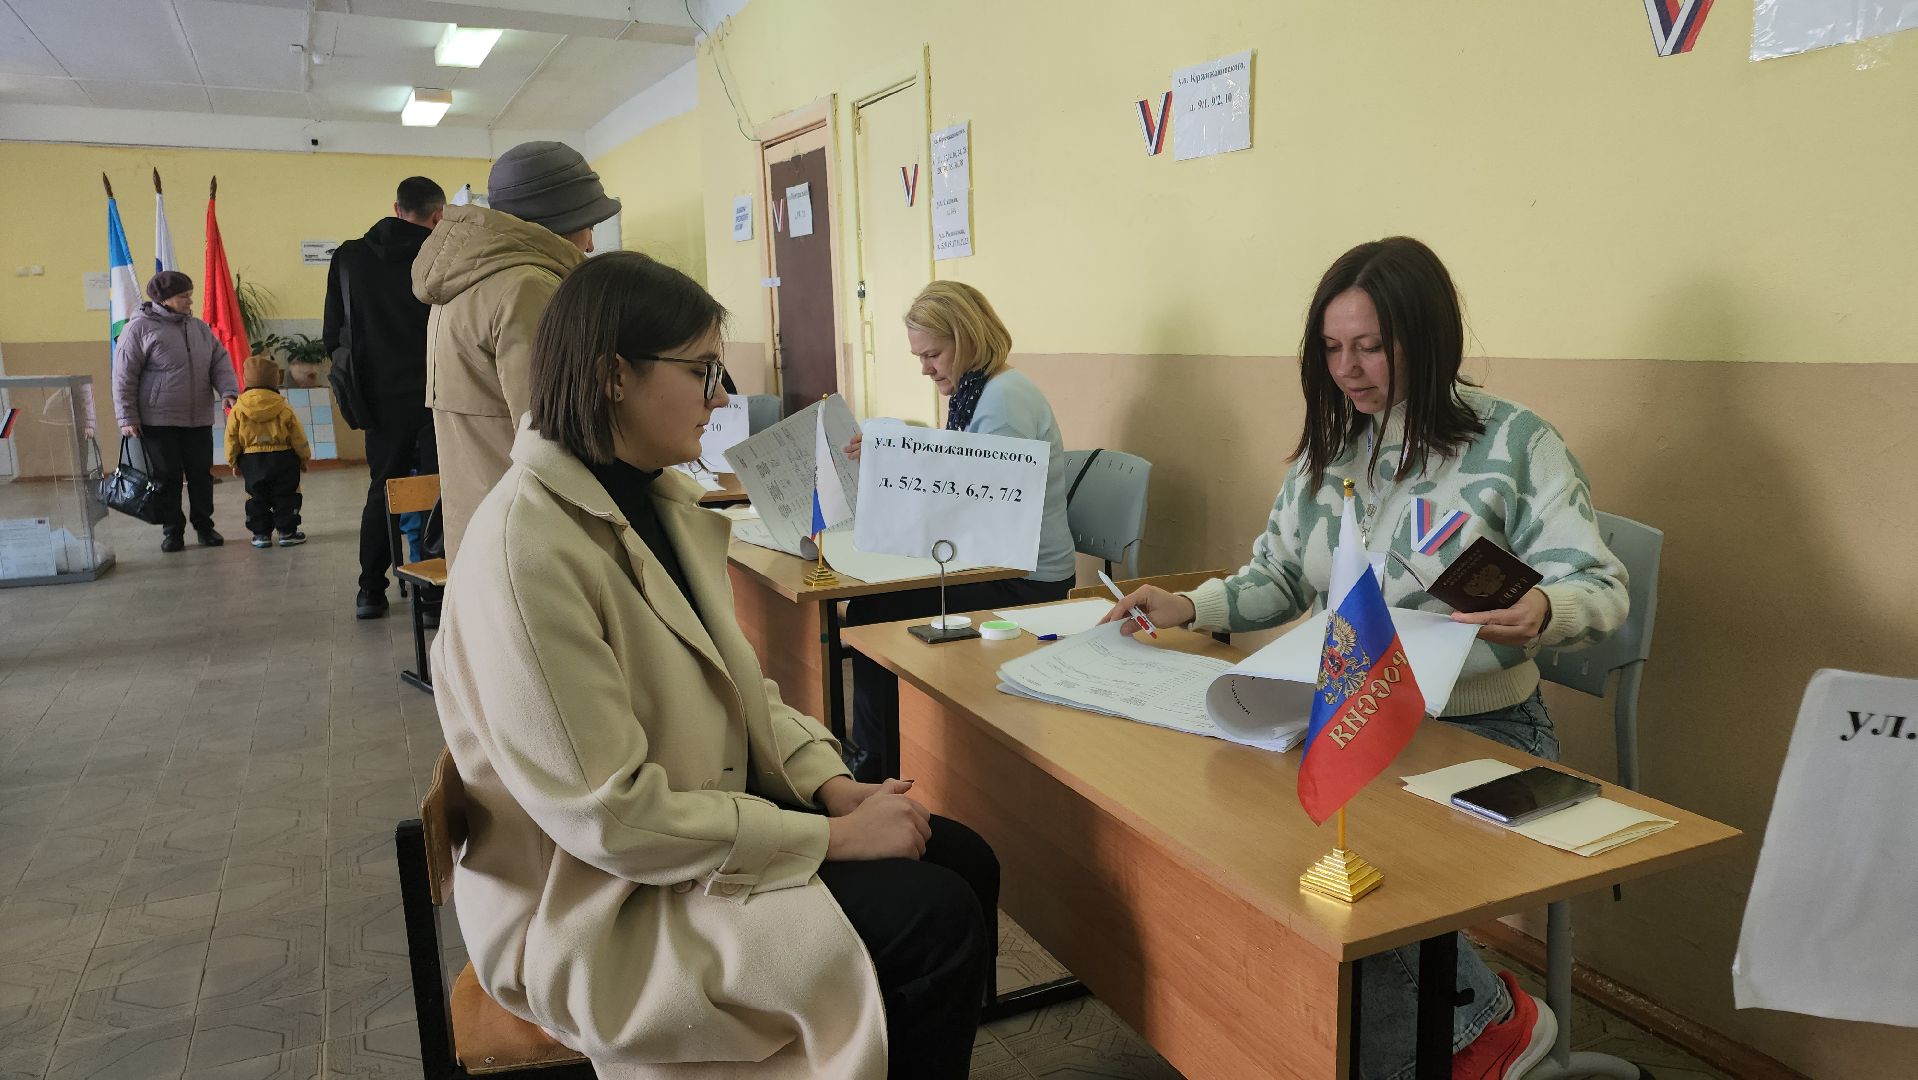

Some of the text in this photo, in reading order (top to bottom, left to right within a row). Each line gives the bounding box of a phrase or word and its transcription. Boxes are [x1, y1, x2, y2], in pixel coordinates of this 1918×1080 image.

[711, 422, 722, 432] 10
[874, 436, 1038, 466] ул. Кржижановского,
[878, 475, 1023, 503] д. 5/2, 5/3, 6,7, 7/2
[1840, 710, 1917, 742] ул.
